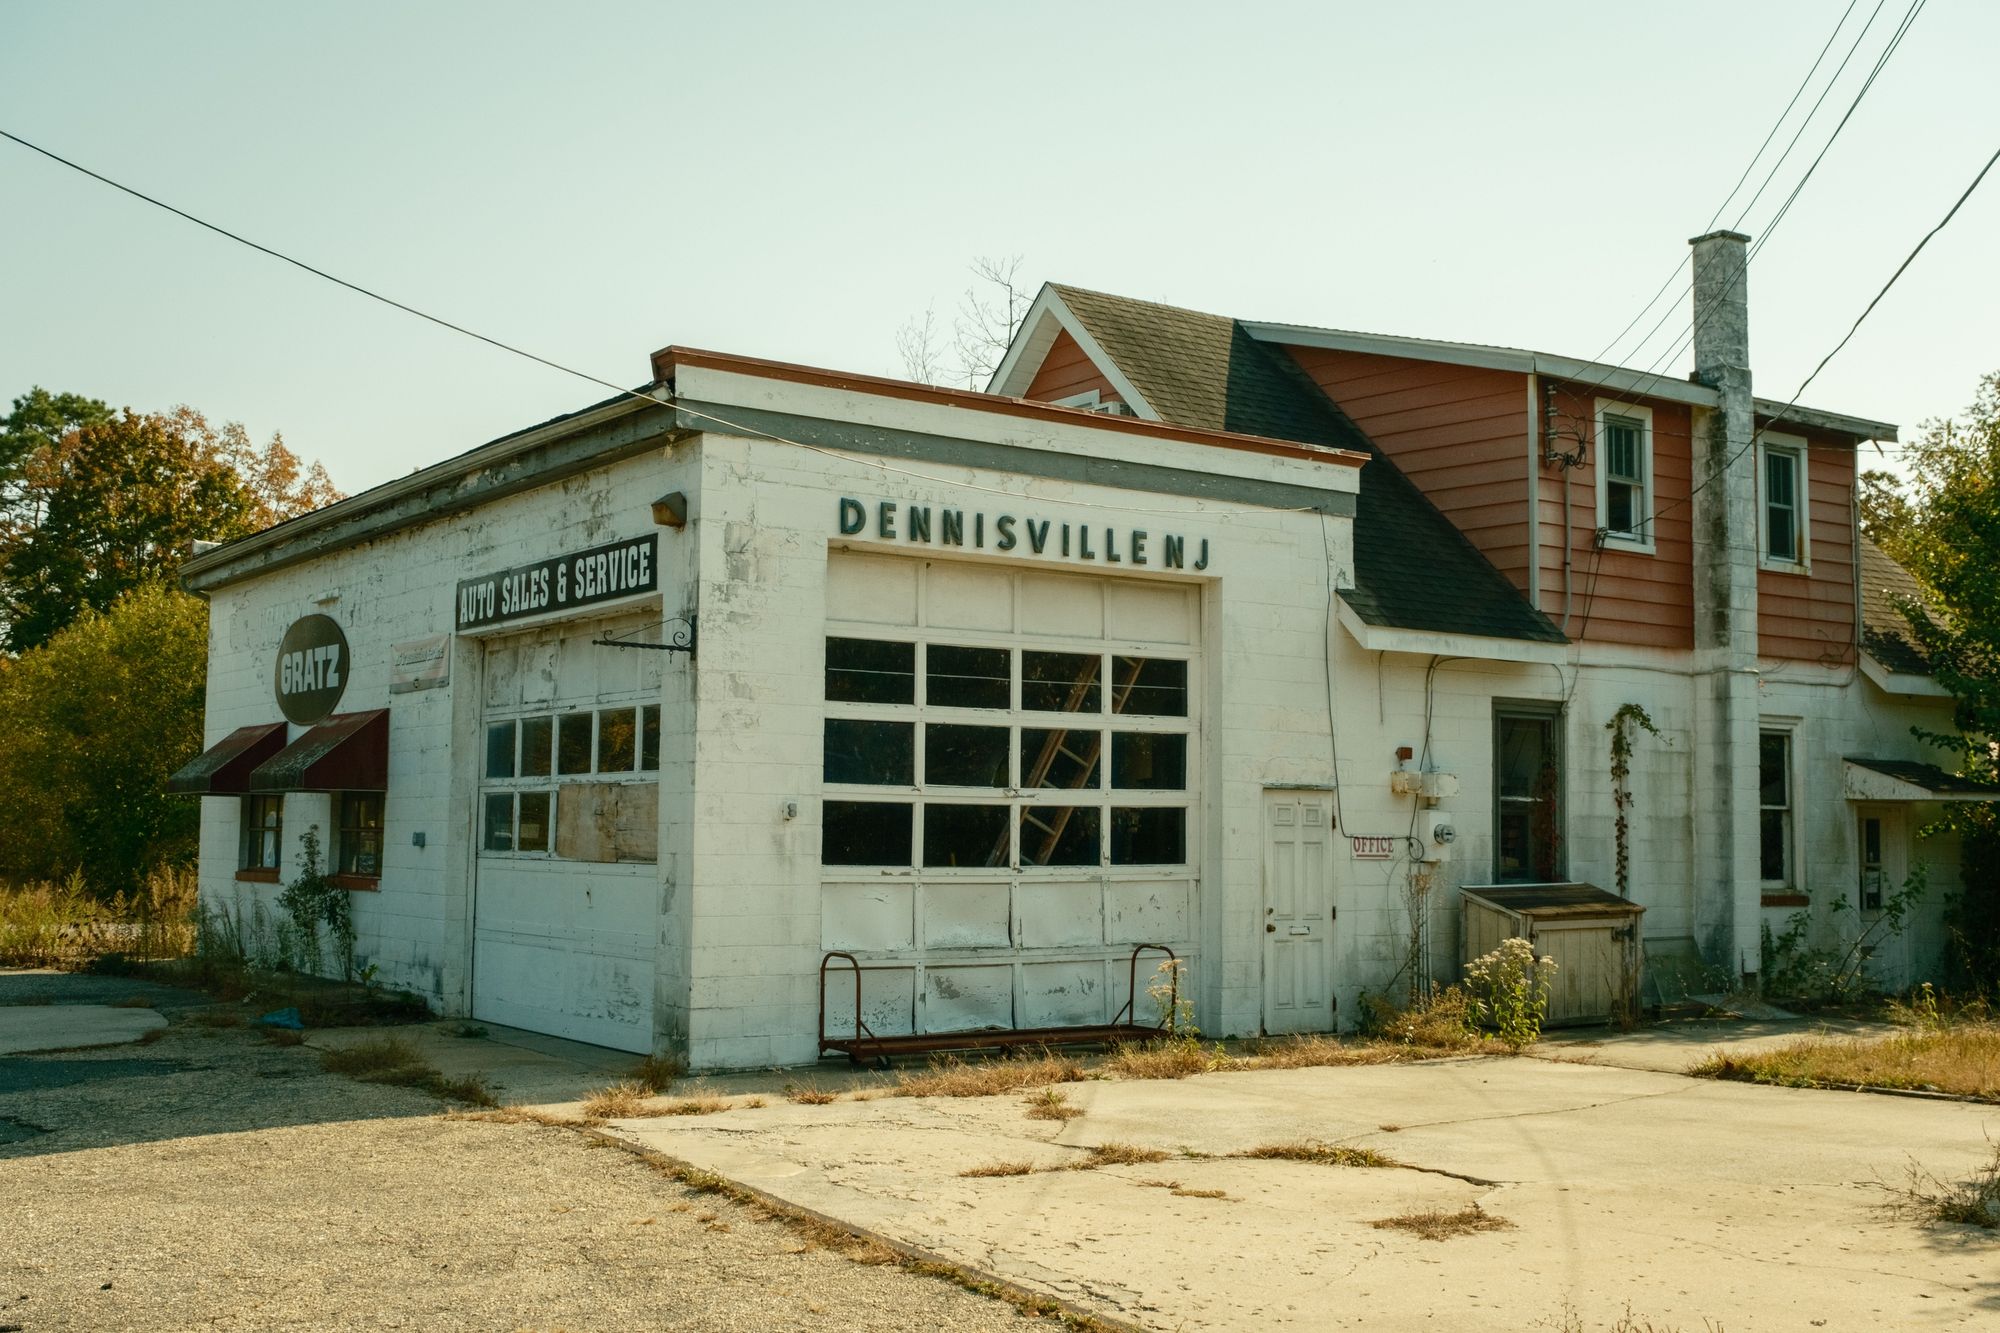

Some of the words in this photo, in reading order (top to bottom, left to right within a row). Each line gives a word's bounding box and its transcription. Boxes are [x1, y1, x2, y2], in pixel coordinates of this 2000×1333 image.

[839, 497, 1148, 564] DENNISVILLE
[1165, 534, 1209, 571] NJ
[460, 580, 496, 624] AUTO
[501, 567, 549, 615] SALES
[557, 562, 567, 603] &
[574, 542, 651, 600] SERVICE
[281, 643, 340, 695] GRATZ
[1353, 836, 1393, 853] OFFICE
